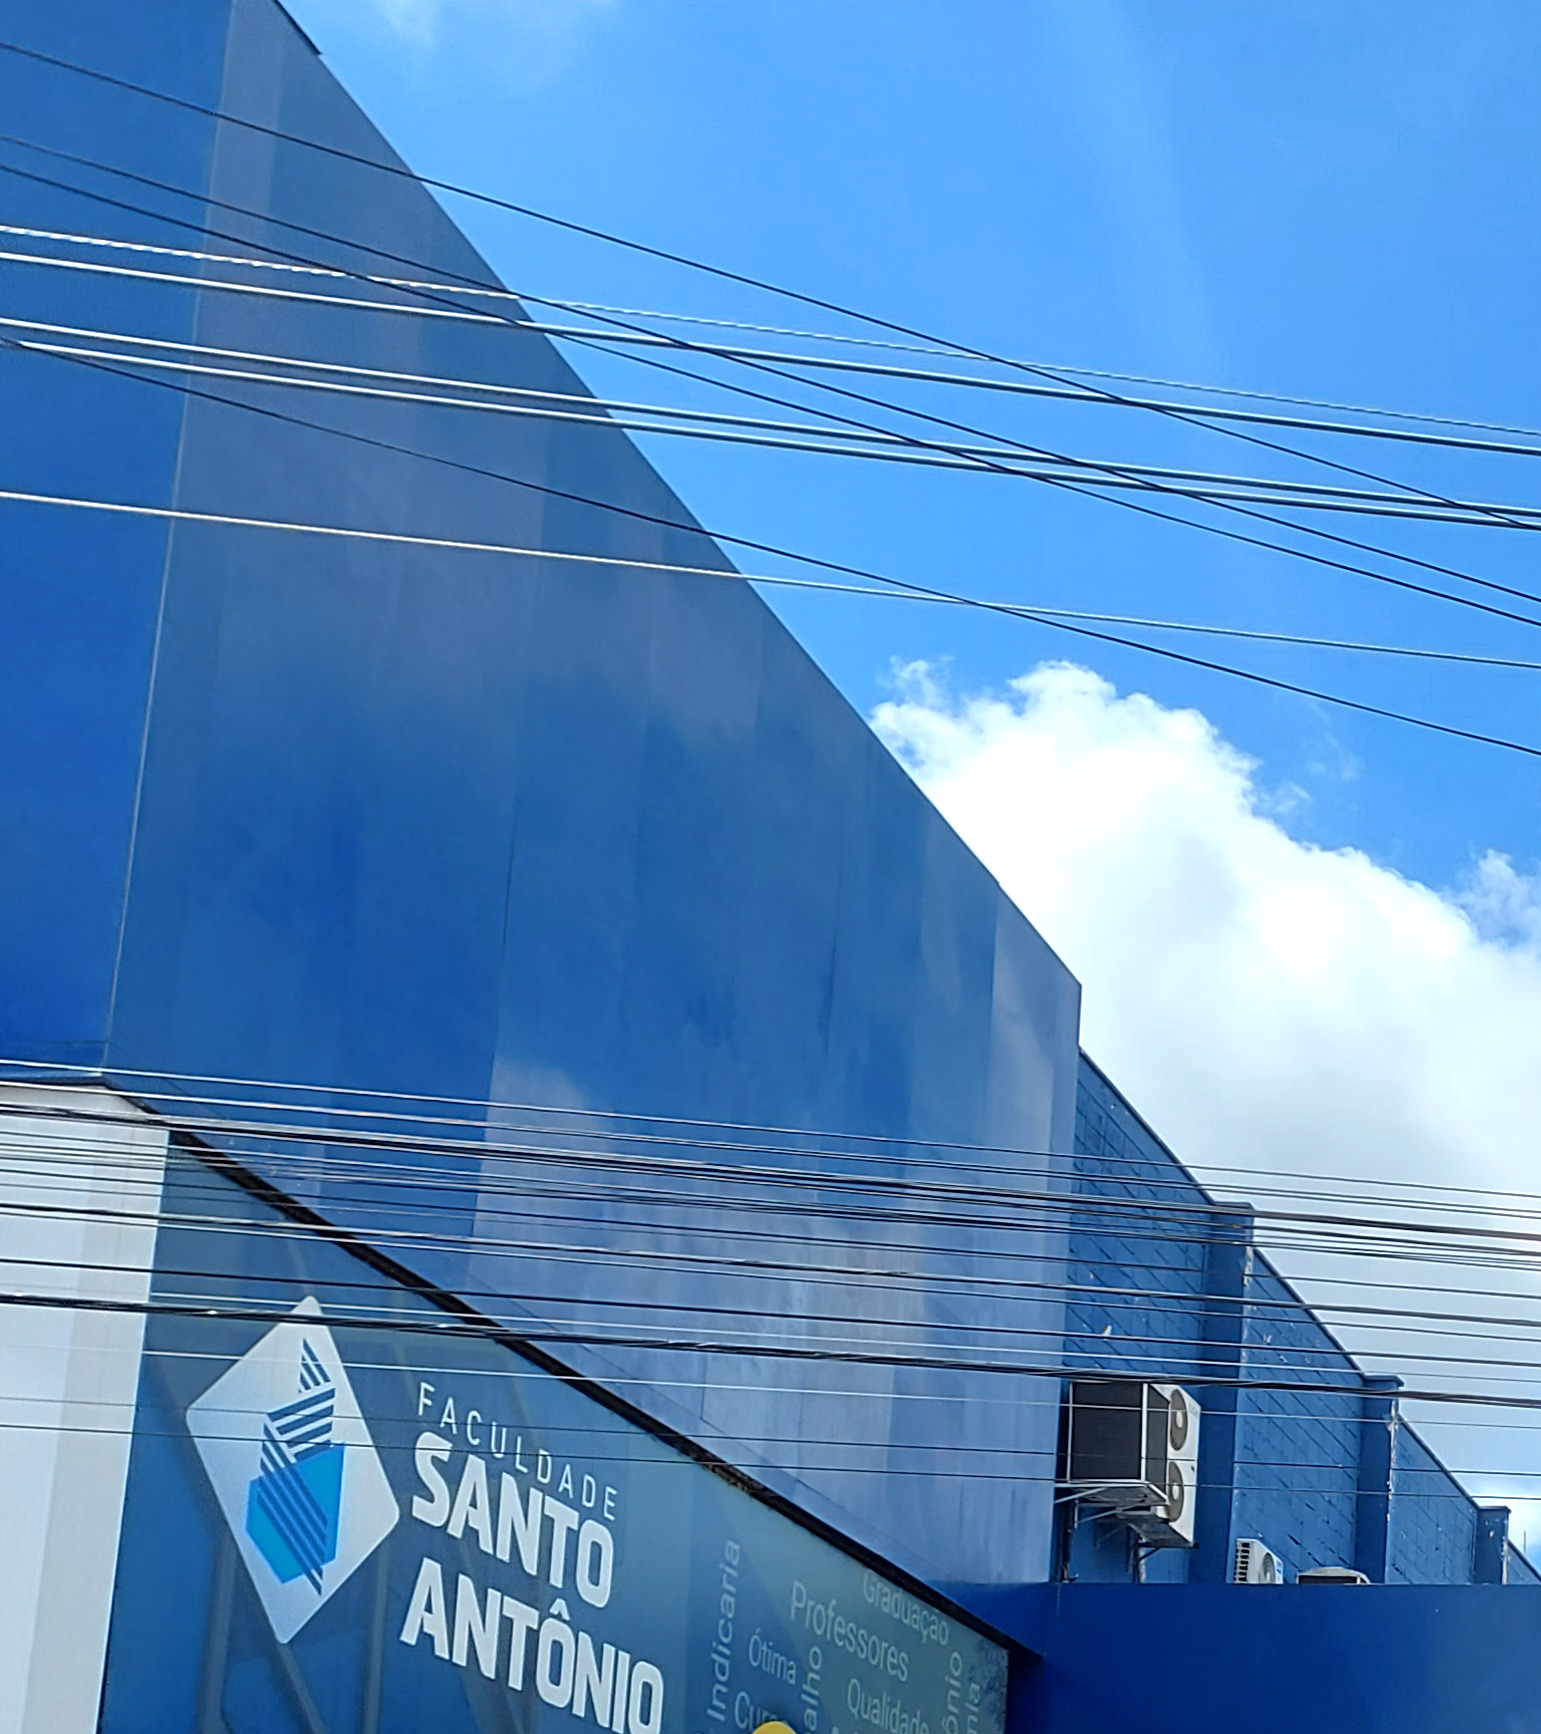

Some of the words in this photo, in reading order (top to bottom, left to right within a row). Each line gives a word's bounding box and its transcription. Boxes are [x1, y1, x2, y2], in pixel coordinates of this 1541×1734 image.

[417, 1381, 620, 1522] FACULDADE
[412, 1432, 615, 1610] SANTO
[705, 1539, 741, 1723] Indicaria
[748, 1627, 797, 1687] Ótima
[790, 1579, 909, 1683] Professores
[863, 1569, 949, 1646] Graduação
